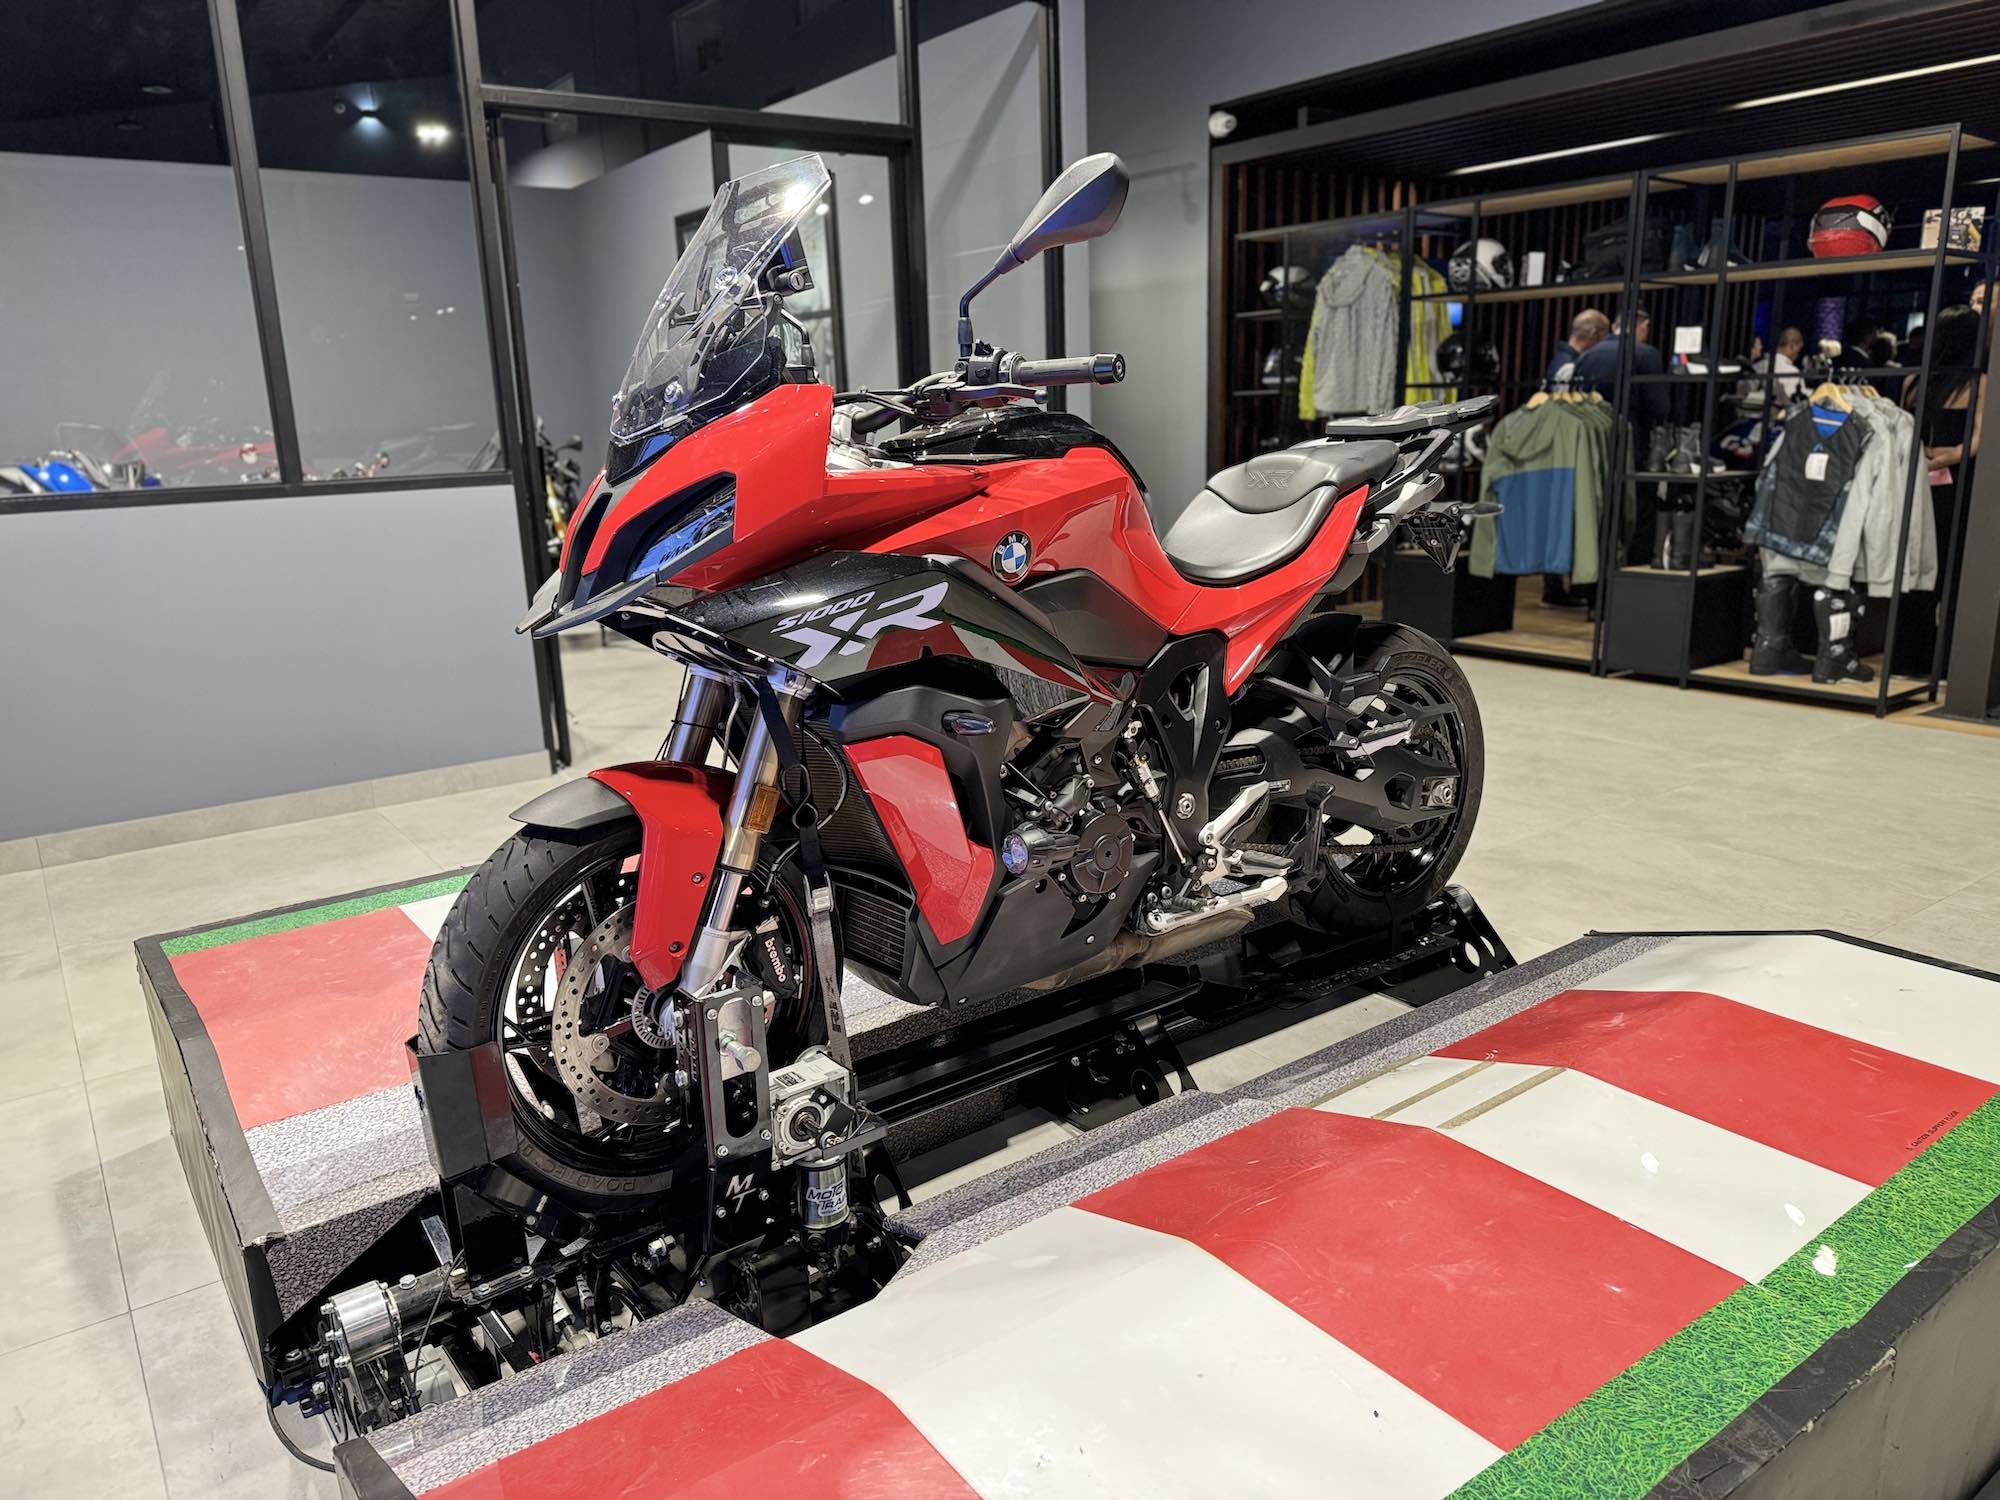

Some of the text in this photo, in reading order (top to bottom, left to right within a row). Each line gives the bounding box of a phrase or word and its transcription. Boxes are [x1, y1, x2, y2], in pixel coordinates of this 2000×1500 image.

[997, 534, 1029, 555] BMW
[770, 591, 876, 634] S1000
[780, 581, 949, 669] XR
[765, 937, 786, 982] brembo
[819, 1197, 844, 1211] TRA
